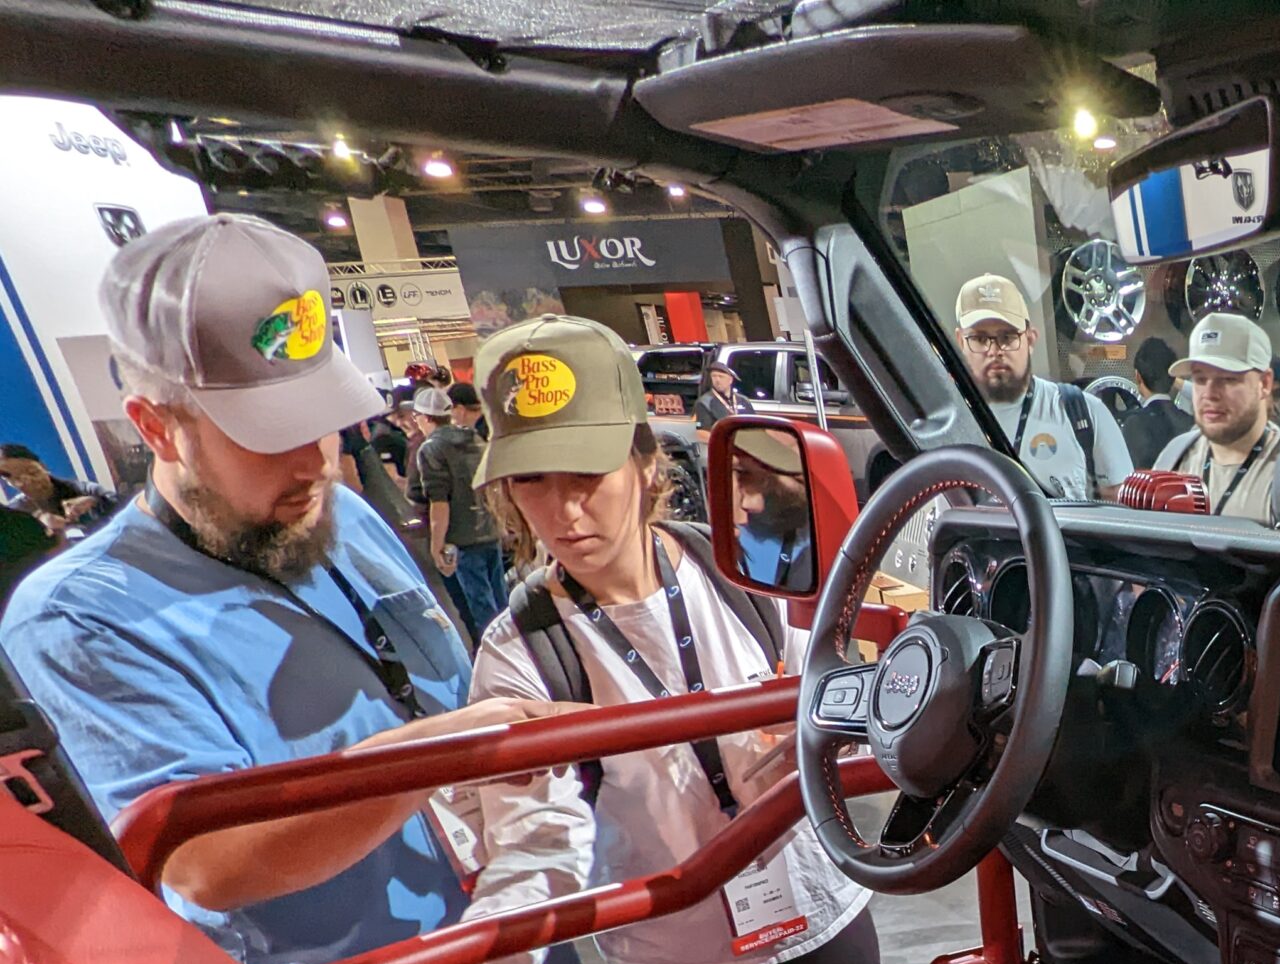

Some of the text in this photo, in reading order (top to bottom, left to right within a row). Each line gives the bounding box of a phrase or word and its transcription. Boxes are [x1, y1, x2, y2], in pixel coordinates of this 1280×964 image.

[48, 121, 128, 166] Jeep
[546, 235, 656, 270] LUXOR
[520, 357, 558, 375] Bass
[525, 374, 550, 390] Pro
[527, 388, 571, 406] Shops
